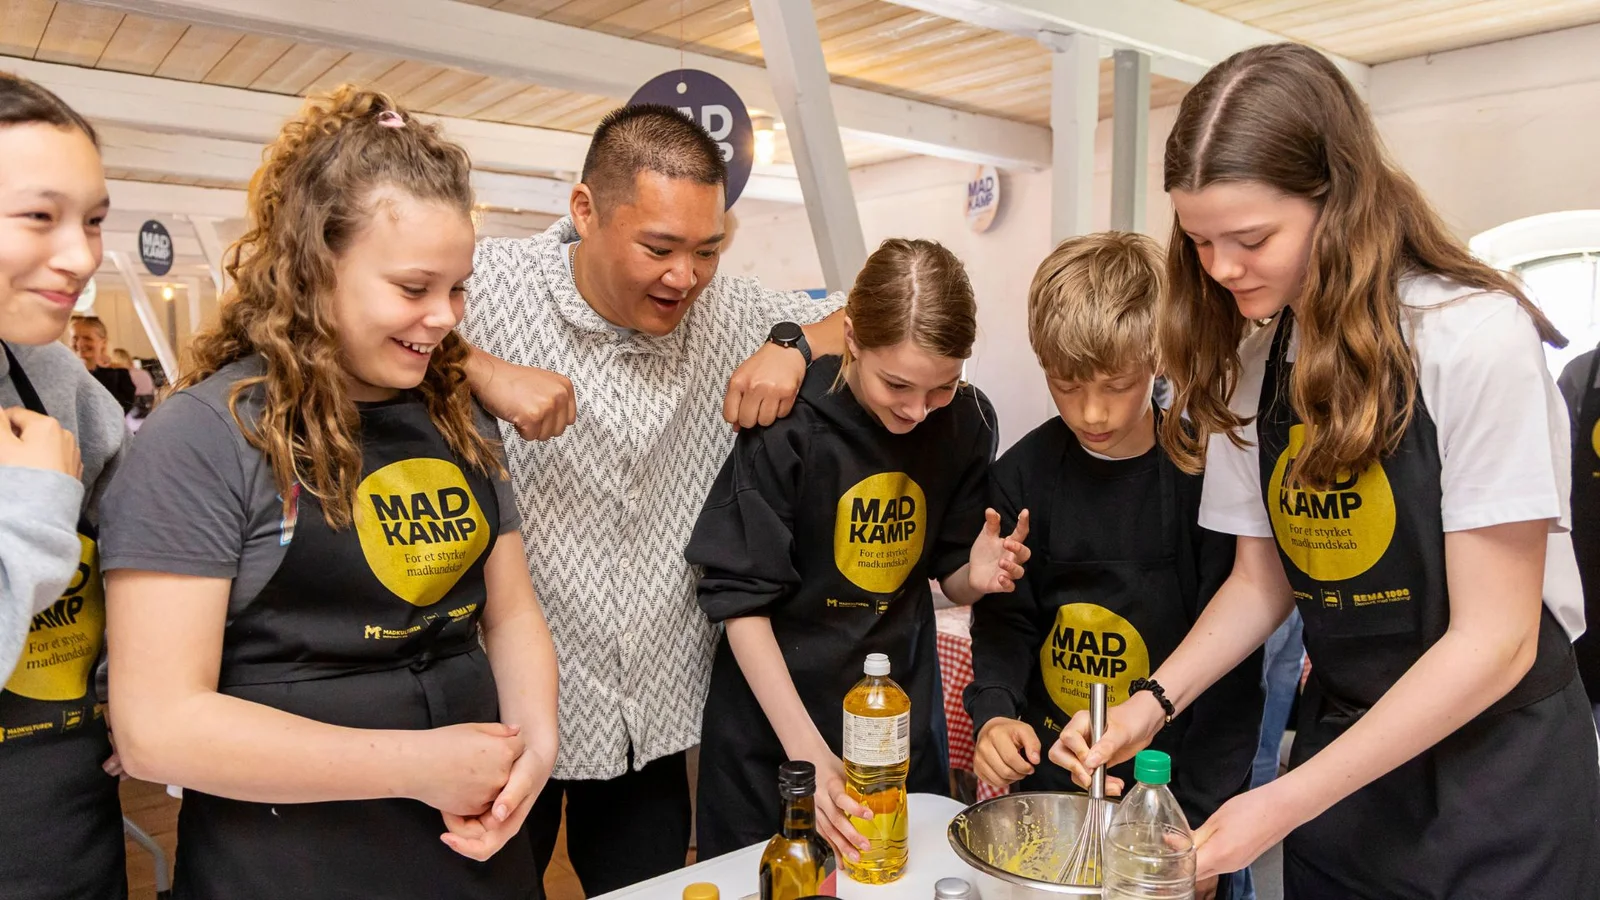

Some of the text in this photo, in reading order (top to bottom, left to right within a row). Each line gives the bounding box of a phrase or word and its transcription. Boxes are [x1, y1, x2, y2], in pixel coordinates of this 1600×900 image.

[968, 176, 994, 196] MAD
[142, 231, 170, 249] MAD
[369, 486, 470, 521] MAD
[851, 496, 915, 523] MAD
[1280, 489, 1363, 519] KAMP
[381, 517, 477, 546] KAMP
[849, 521, 916, 544] KAMP
[1289, 524, 1353, 538] For et styrket
[1291, 537, 1358, 550] madkundskab
[404, 549, 466, 563] For et styrket
[858, 557, 909, 569] madkundskab
[859, 549, 874, 557] For
[876, 551, 884, 559] et
[1353, 588, 1410, 602] REMA 1000
[29, 595, 84, 632] AMP
[29, 640, 49, 654] For
[51, 638, 61, 649] et
[1052, 624, 1127, 657] MAD
[1052, 648, 1127, 678] KAMP
[1062, 675, 1083, 687] For et
[1061, 685, 1116, 703] madkunb
